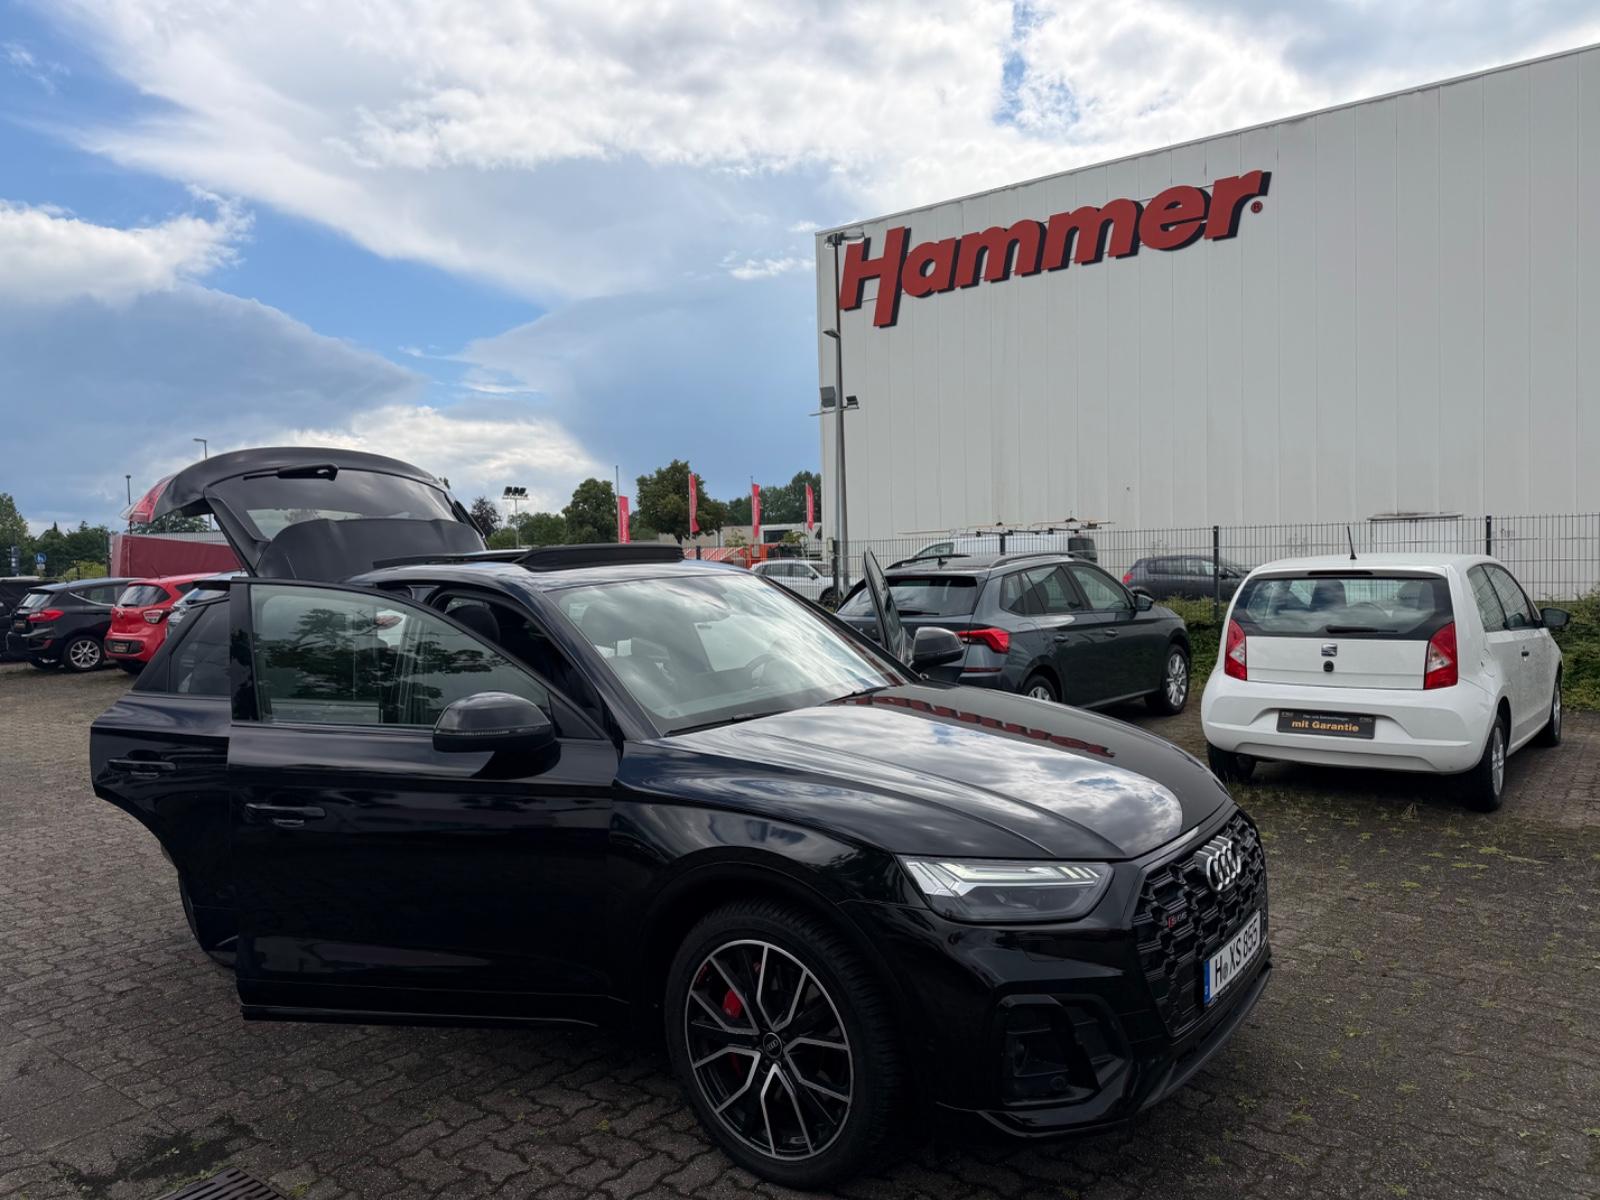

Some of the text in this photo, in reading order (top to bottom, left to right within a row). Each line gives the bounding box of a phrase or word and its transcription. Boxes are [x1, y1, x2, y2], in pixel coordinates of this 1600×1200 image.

[839, 170, 1271, 328] Hammer
[1291, 719, 1309, 729] mit
[1311, 720, 1360, 732] Garantie
[1215, 955, 1223, 988] H
